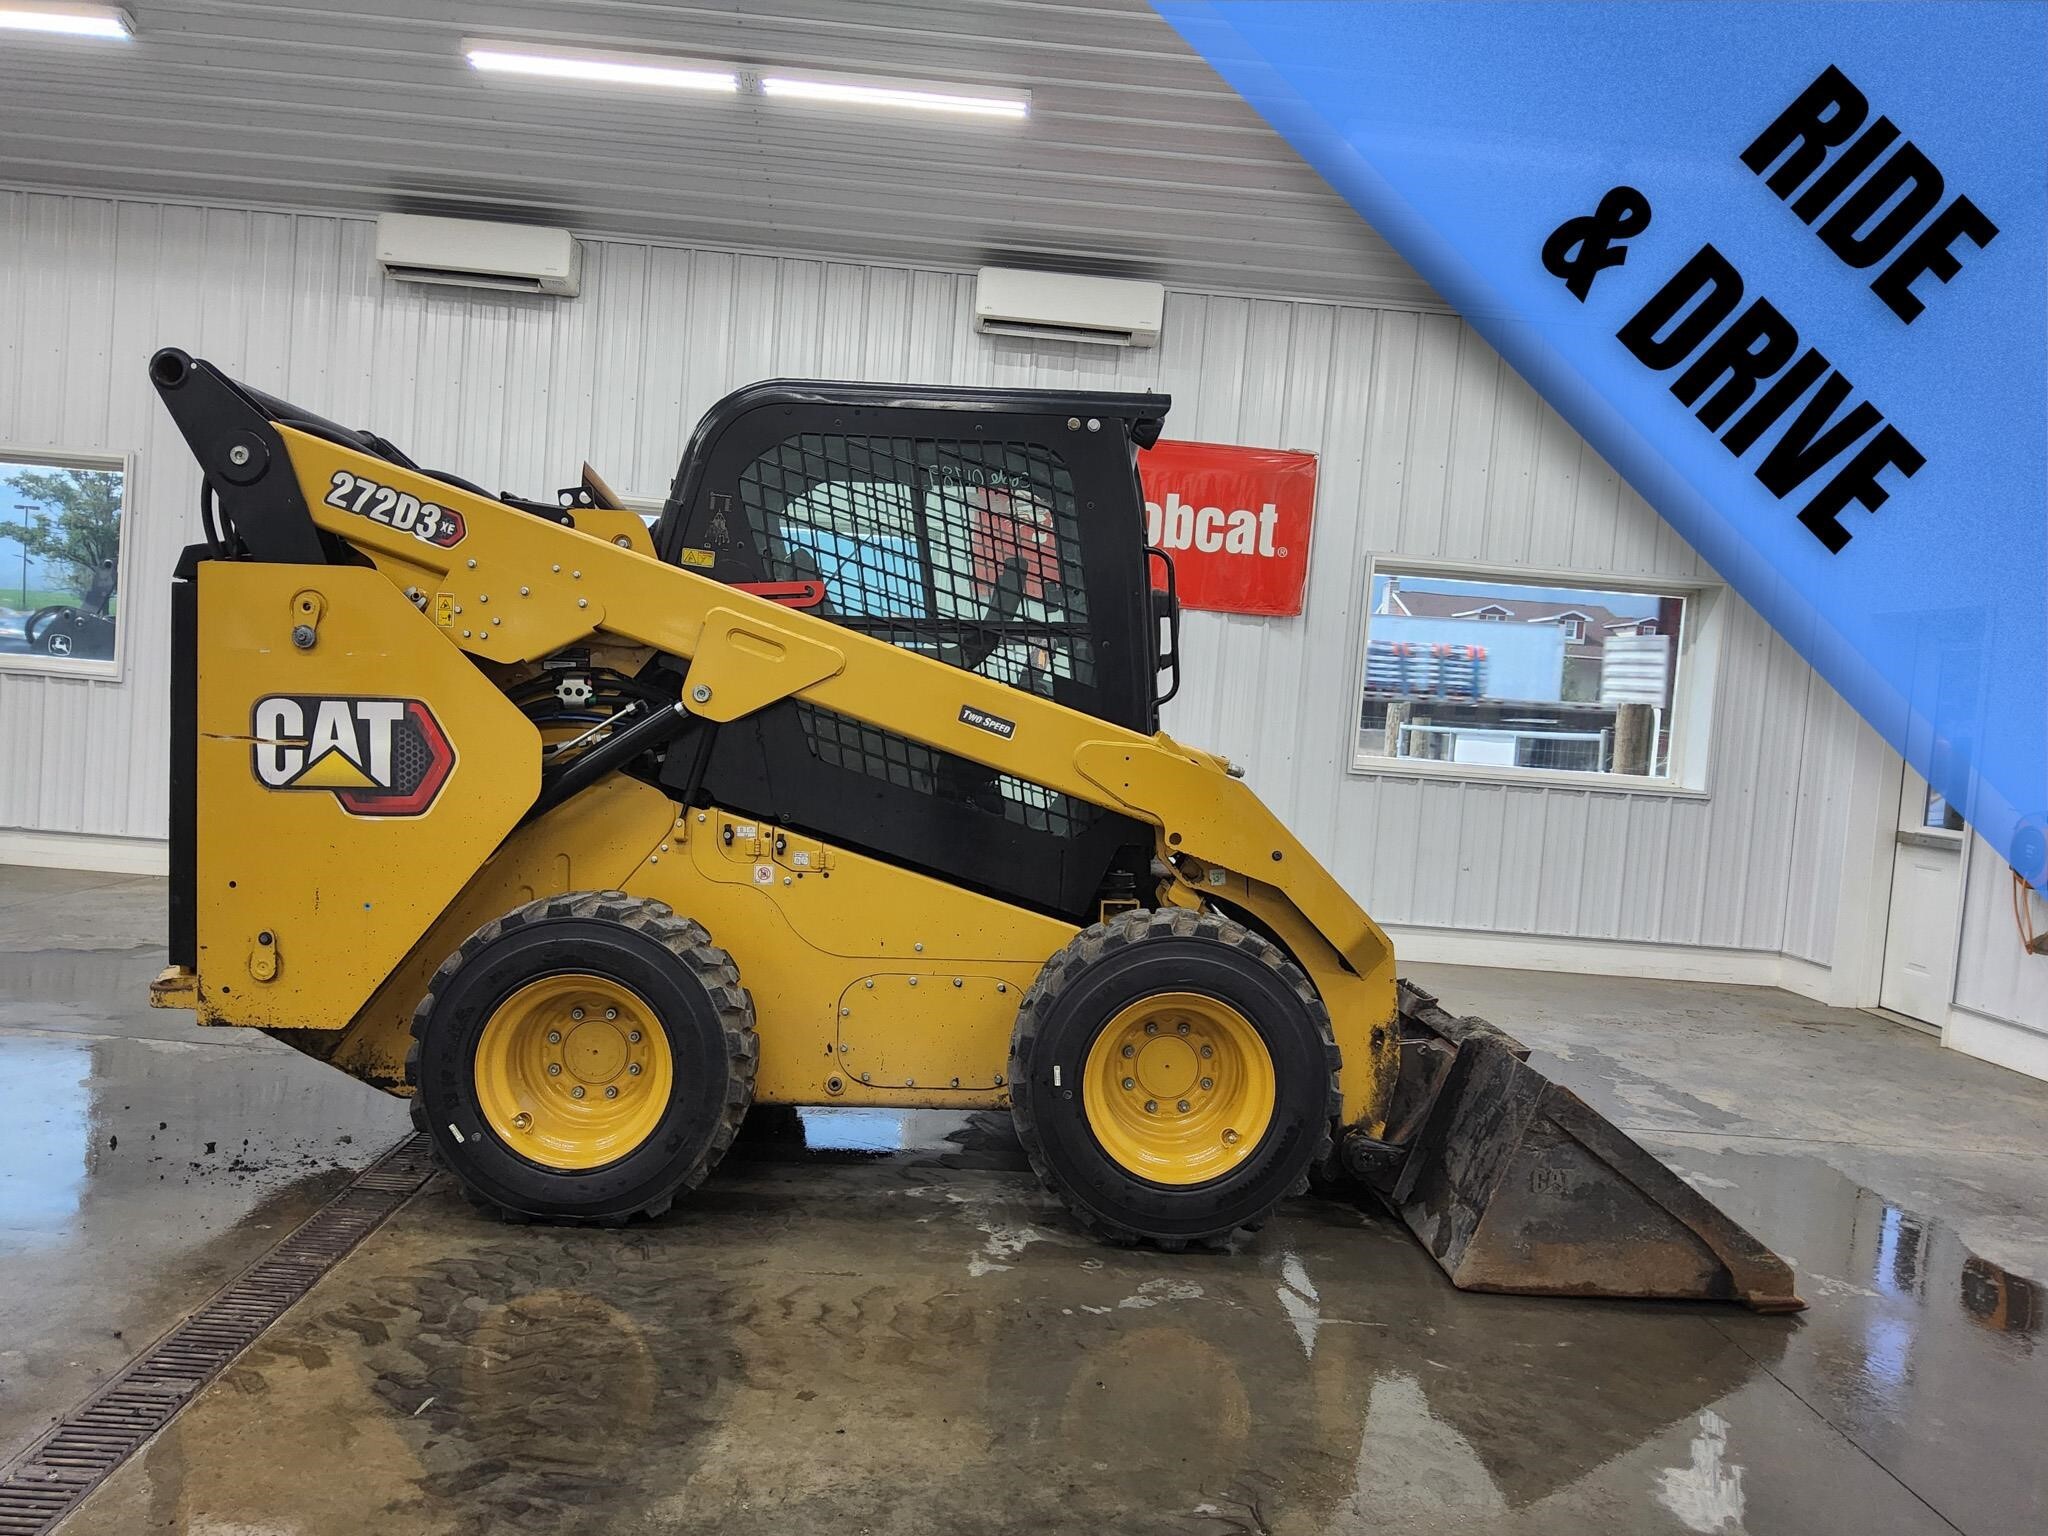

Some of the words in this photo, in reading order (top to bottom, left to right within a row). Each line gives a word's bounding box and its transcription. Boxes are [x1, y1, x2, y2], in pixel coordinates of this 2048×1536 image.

[325, 471, 442, 540] 272D3
[440, 520, 456, 536] XE
[1144, 494, 1279, 558] obcat
[255, 698, 405, 787] CAT
[1530, 1168, 1577, 1194] CAT
